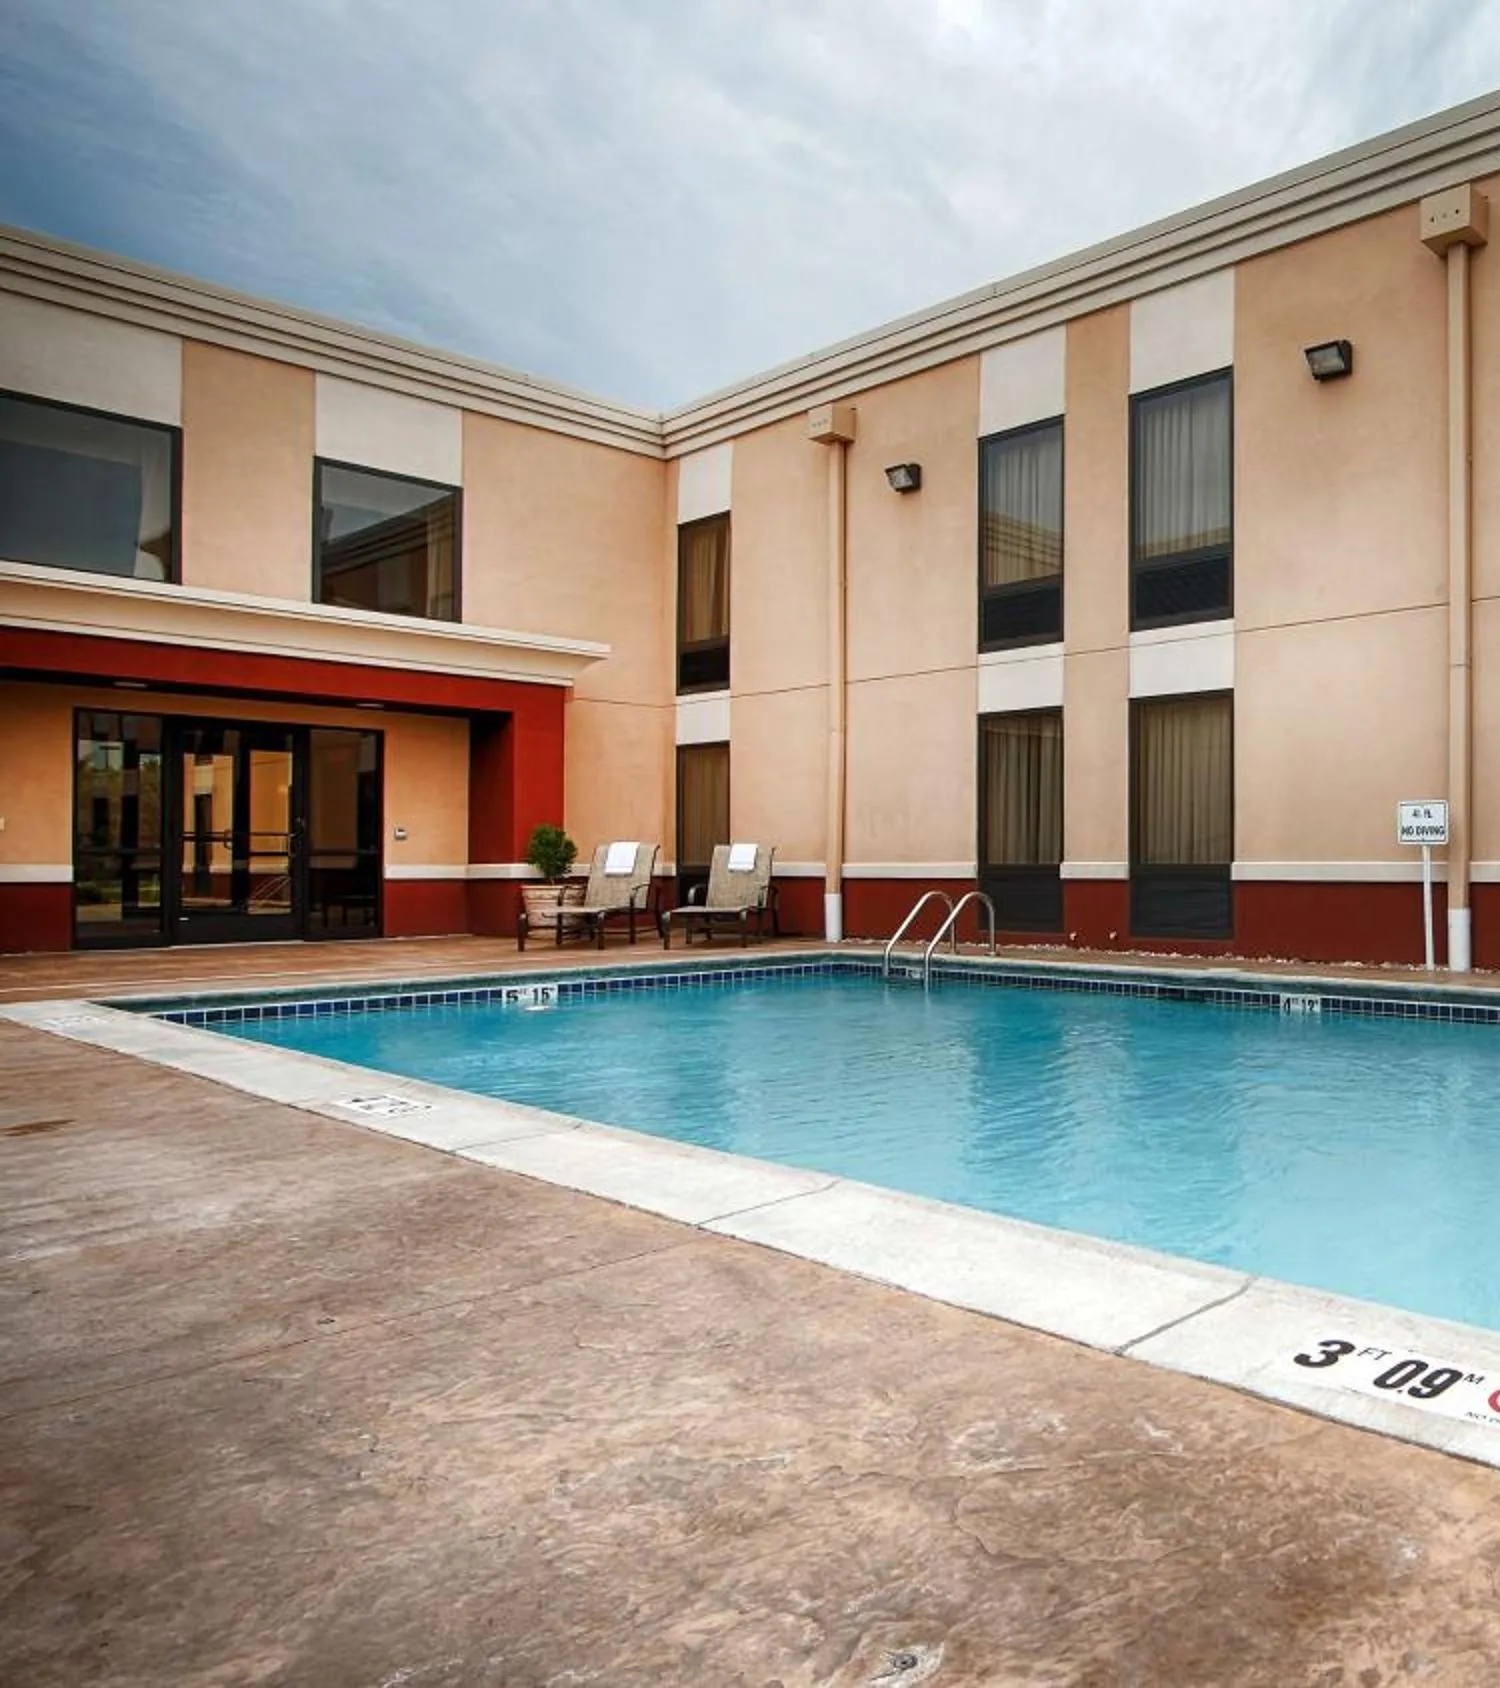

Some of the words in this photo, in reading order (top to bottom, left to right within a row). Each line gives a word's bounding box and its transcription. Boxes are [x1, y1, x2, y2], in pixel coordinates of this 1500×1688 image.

[1401, 825, 1415, 836] NO
[1416, 825, 1446, 836] DIVING
[1293, 1339, 1356, 1368] 3
[1356, 1346, 1393, 1361] FT
[1463, 1373, 1486, 1385] M
